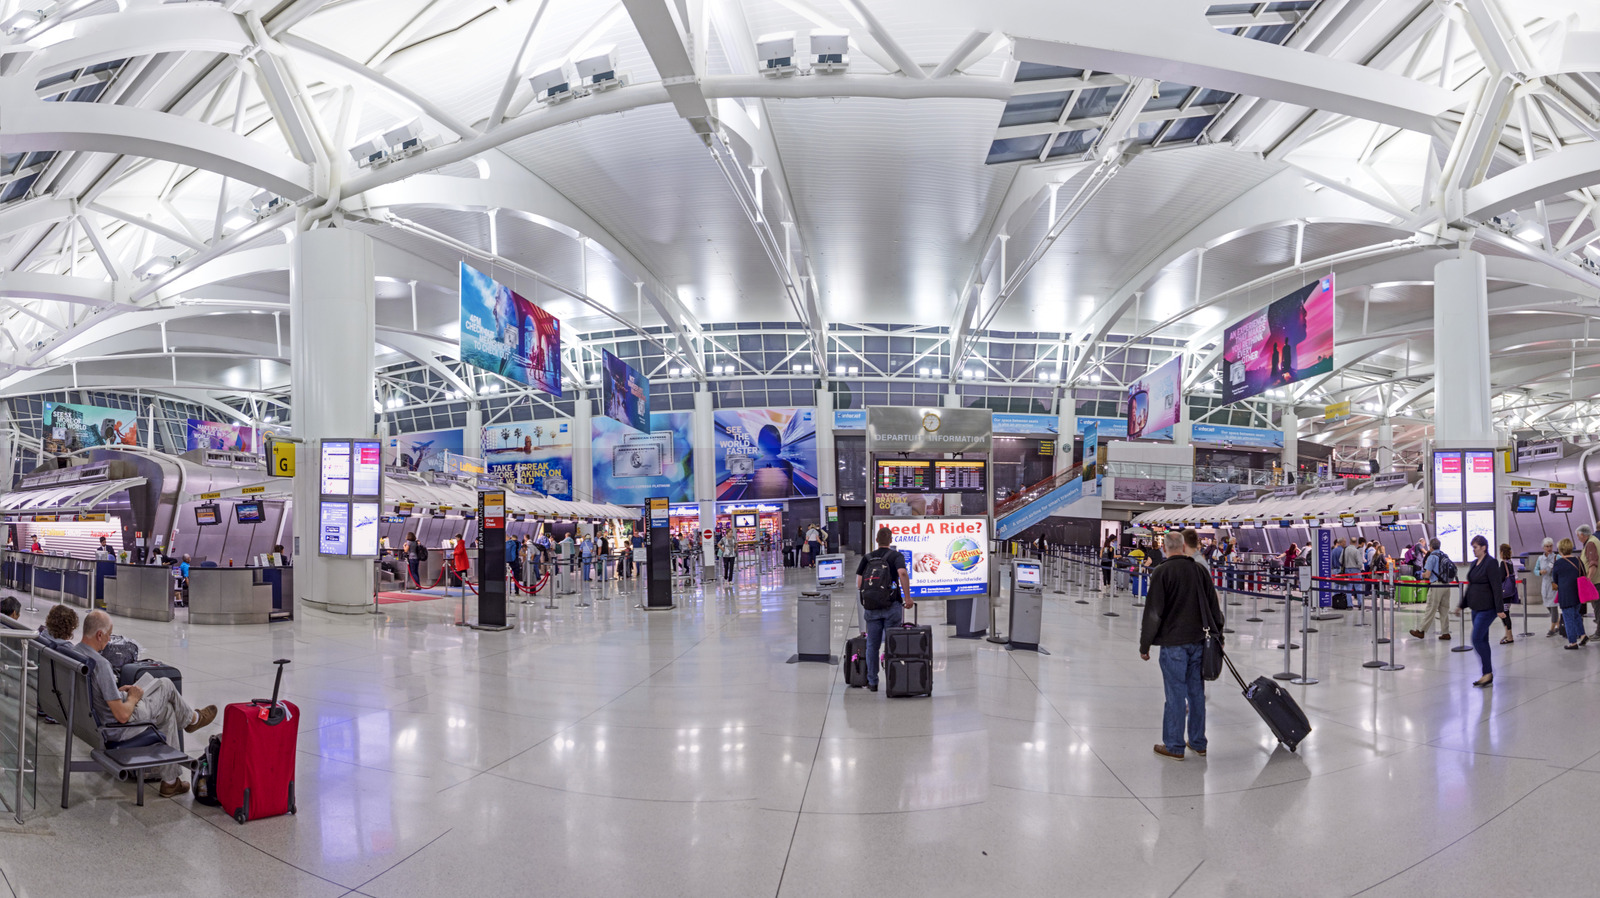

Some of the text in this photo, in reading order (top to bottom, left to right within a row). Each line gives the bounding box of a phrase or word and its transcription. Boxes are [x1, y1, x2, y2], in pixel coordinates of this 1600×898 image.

[1236, 314, 1266, 334] EXPERIENCE
[1238, 347, 1252, 358] EVERY
[1242, 351, 1258, 364] OTHER
[726, 446, 758, 455] FASTER
[280, 458, 288, 472] G
[460, 461, 484, 473] Lufthansa
[879, 522, 982, 534] Need A Ride?
[951, 549, 982, 561] CARMEL
